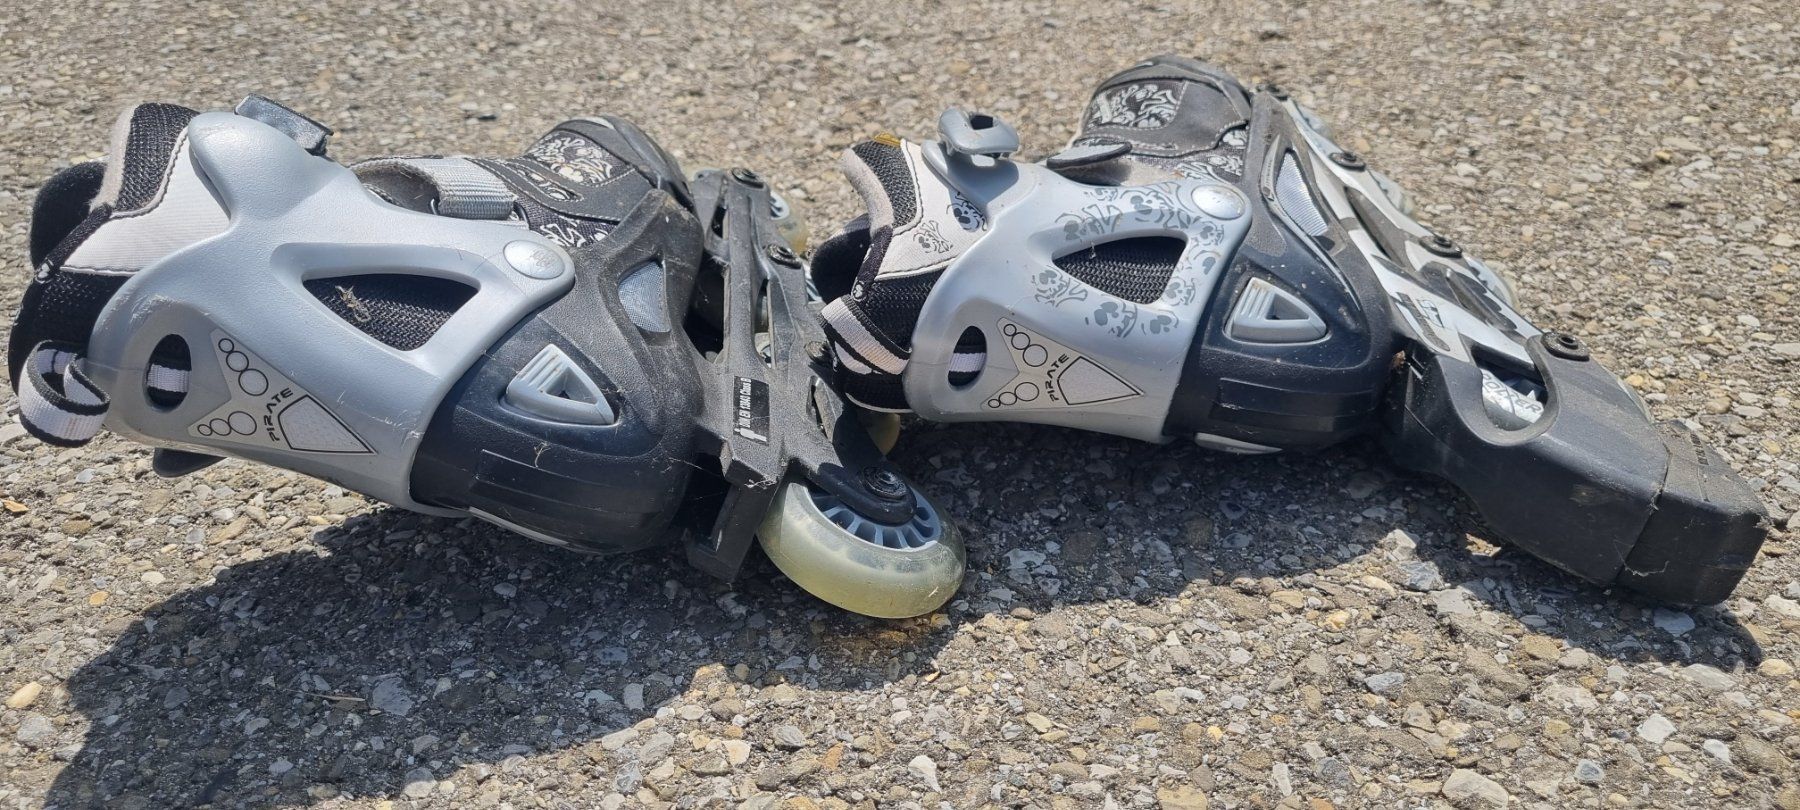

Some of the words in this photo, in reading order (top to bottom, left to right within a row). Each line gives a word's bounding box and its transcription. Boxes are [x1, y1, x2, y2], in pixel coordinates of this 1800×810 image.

[739, 382, 751, 396] Class
[1045, 353, 1069, 402] PIRATE
[263, 387, 294, 442] PIRATE
[739, 409, 751, 418] EN
